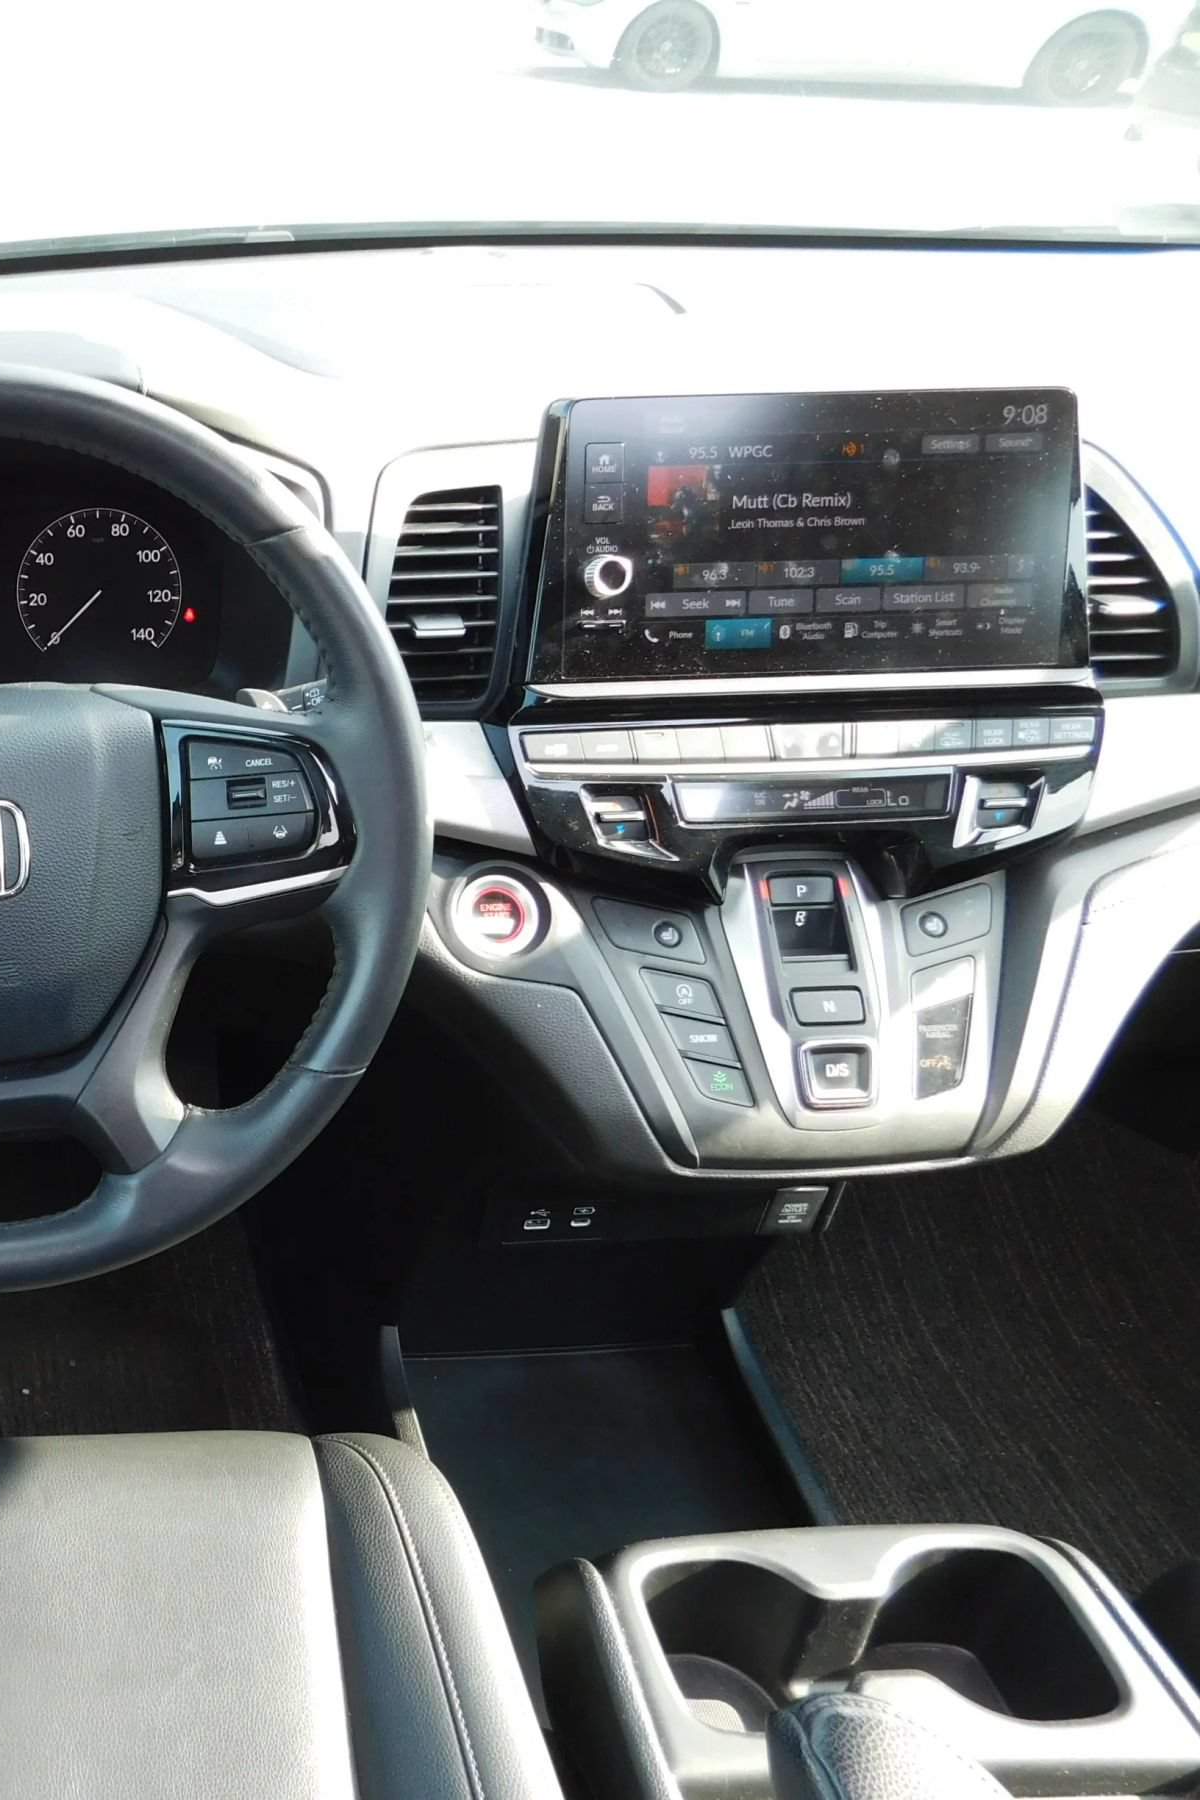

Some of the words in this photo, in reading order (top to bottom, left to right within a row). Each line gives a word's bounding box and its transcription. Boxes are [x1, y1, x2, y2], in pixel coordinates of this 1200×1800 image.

[1002, 404, 1048, 425] 9:08
[930, 440, 970, 450] Settings
[999, 437, 1030, 448] Sound
[689, 447, 718, 459] 95.5
[728, 445, 773, 458] WPGC
[592, 465, 617, 473] HOME
[732, 494, 768, 509] Mutt
[772, 493, 797, 510] (Cb
[802, 492, 852, 509] Remix)
[592, 503, 614, 512] BACK
[731, 519, 754, 529] Leon
[757, 518, 794, 529] Thomas
[796, 518, 804, 528] &
[807, 517, 831, 527] Chris
[834, 516, 865, 526] Brown
[66, 525, 86, 538] 60
[111, 523, 130, 536] 80
[595, 537, 610, 545] VOL
[595, 545, 618, 553] AUDIO
[36, 552, 54, 566] 40
[136, 550, 160, 562] 100
[702, 568, 728, 581] 96.3
[783, 568, 815, 578] 102.3
[868, 564, 895, 577] 95.5
[29, 593, 47, 606] 20
[147, 589, 172, 603] 120
[834, 594, 861, 606] Scan
[893, 592, 932, 604] Station
[935, 592, 955, 603] List
[683, 599, 709, 610] Seek
[768, 596, 794, 608] Tune
[796, 622, 832, 630] Bluetooth
[874, 620, 887, 629] Trip
[936, 618, 958, 626] Smart
[50, 632, 60, 644] 0
[130, 628, 154, 640] 140
[669, 630, 693, 640] Phone
[740, 630, 754, 638] FM
[802, 632, 824, 640] Audio
[861, 631, 898, 640] Computer
[928, 628, 963, 637] Shortcuts
[246, 758, 274, 768] CANCEL
[272, 780, 296, 788] RES/+
[796, 884, 807, 898] P
[480, 903, 512, 912] ENGINE
[795, 911, 806, 922] R
[822, 1000, 837, 1013] N
[689, 1034, 718, 1043] SNOW
[825, 1063, 850, 1078] D/S
[710, 1083, 734, 1091] ECON
